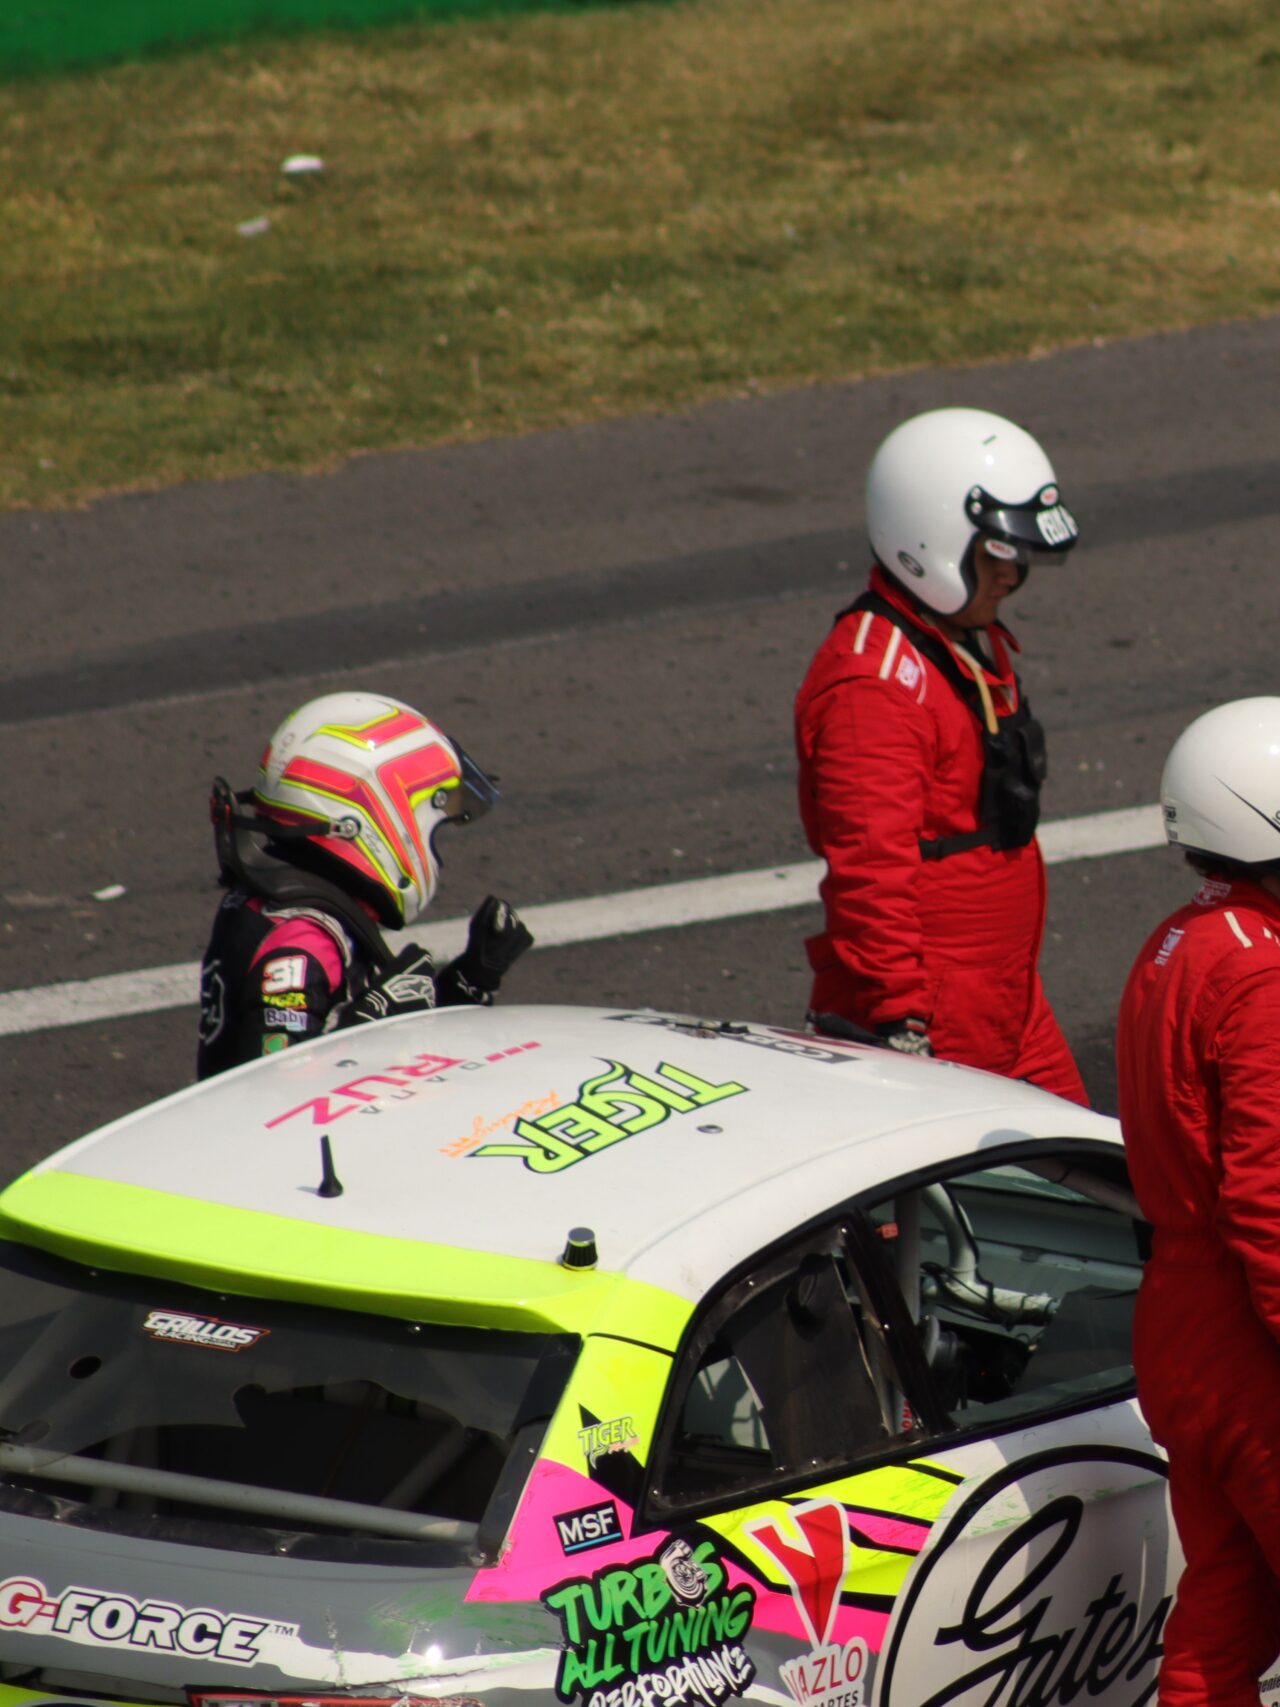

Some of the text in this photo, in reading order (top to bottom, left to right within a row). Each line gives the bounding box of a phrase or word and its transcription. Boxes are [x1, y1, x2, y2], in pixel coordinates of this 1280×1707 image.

[262, 955, 307, 993] 31
[465, 1056, 749, 1174] TIGER
[144, 1313, 260, 1343] GRILLOS
[578, 1417, 637, 1468] TIGER
[557, 1507, 615, 1545] MSF
[0, 1581, 268, 1662] G-FORCE
[561, 1591, 752, 1696] ALL TUNING
[784, 1646, 862, 1706] VAZLO
